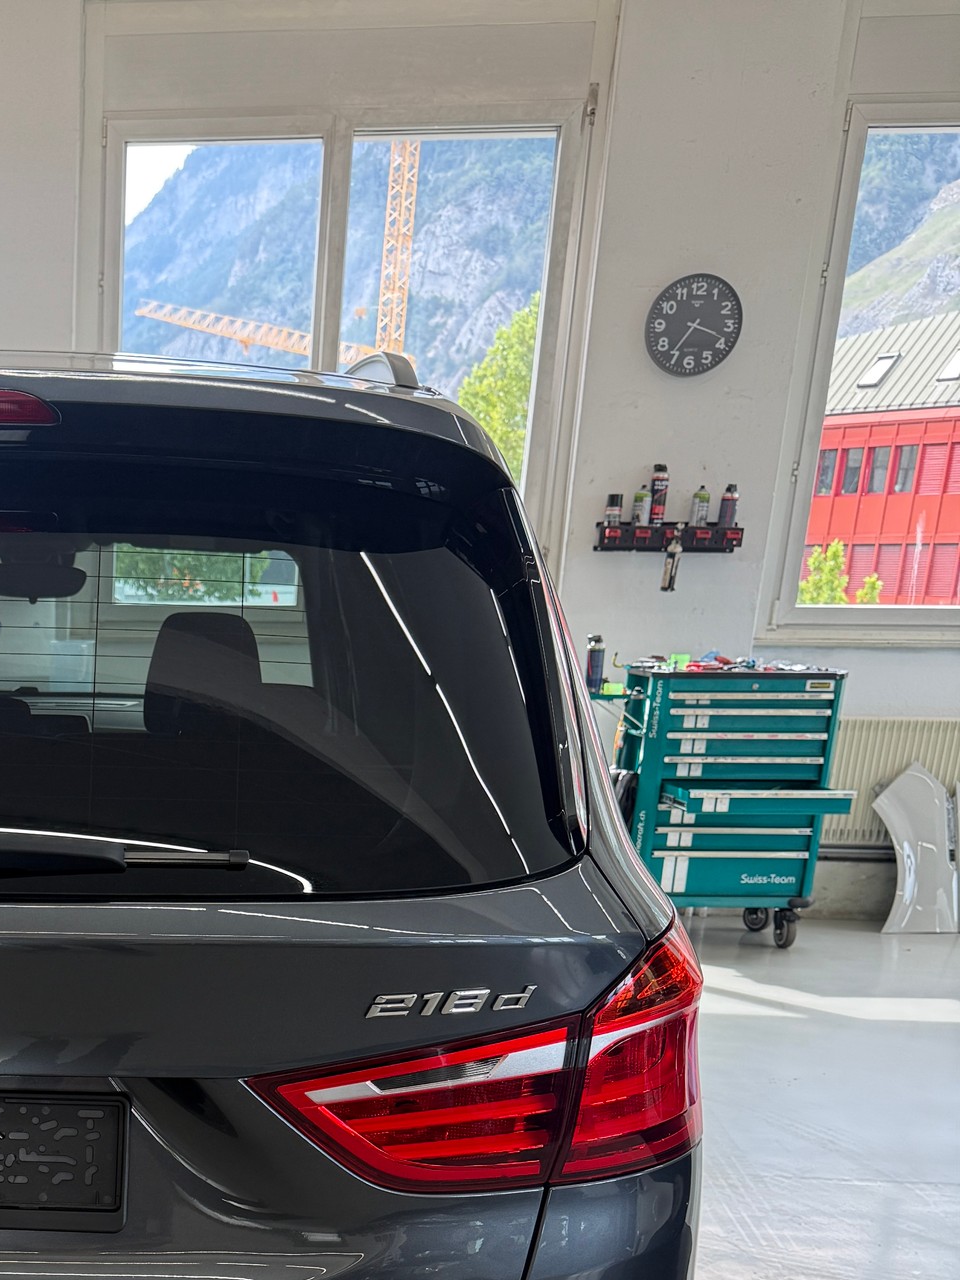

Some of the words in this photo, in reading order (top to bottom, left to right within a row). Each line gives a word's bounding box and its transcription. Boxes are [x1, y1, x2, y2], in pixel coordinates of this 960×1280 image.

[676, 287, 688, 300] 11
[691, 282, 707, 295] 12
[712, 287, 719, 300] 1
[661, 300, 677, 314] 10
[720, 301, 732, 314] 2
[654, 319, 666, 332] 9
[723, 319, 735, 332] 3
[657, 337, 669, 351] 8
[715, 337, 726, 350] 4
[670, 350, 680, 364] 7
[683, 355, 695, 369] 6
[701, 351, 713, 364] 5
[648, 680, 664, 738] Swiss-Team
[740, 873, 796, 884] Swiss-Team
